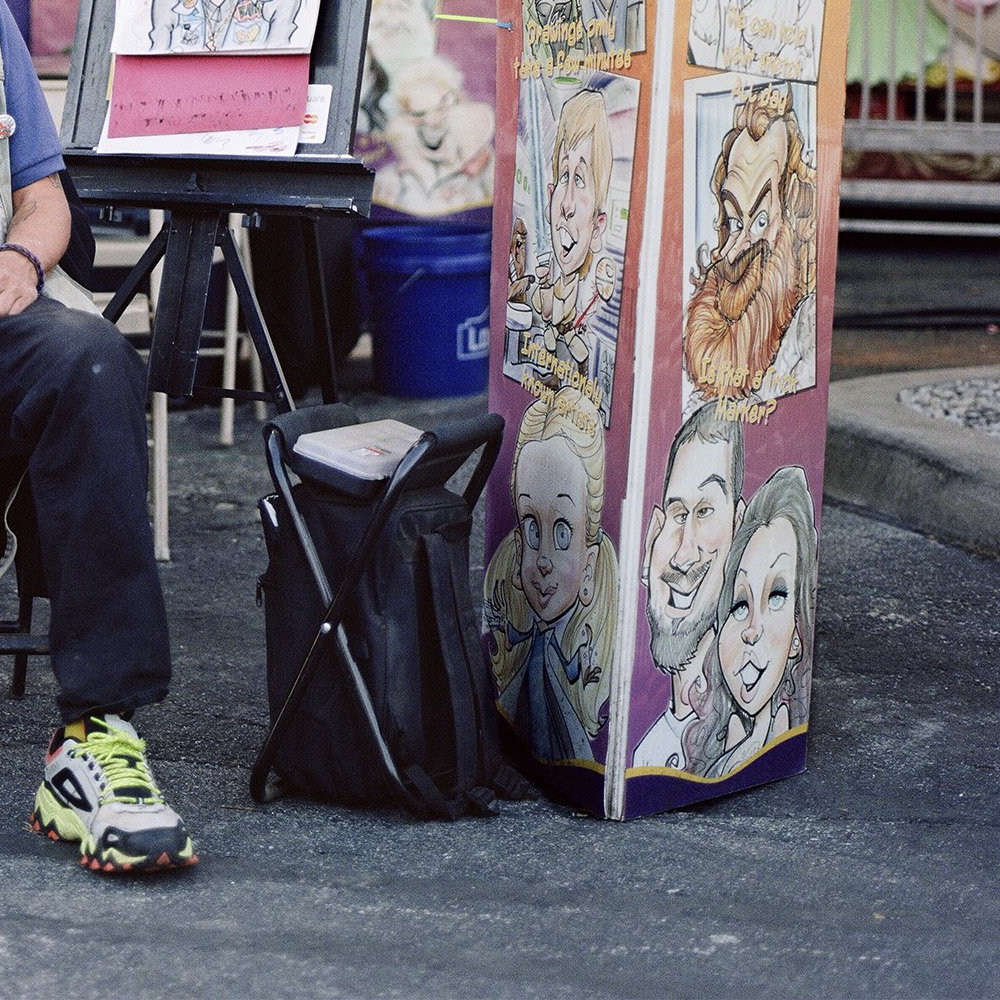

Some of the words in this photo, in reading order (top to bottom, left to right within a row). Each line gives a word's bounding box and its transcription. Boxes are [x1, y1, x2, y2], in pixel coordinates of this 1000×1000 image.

[527, 20, 582, 46] Drawings
[588, 17, 616, 42] only
[513, 56, 540, 79] take
[546, 56, 554, 77] a
[557, 50, 580, 75] few
[584, 47, 632, 75] minutes
[698, 358, 716, 386] Is
[752, 370, 763, 390] a
[715, 395, 777, 425] Marker?
